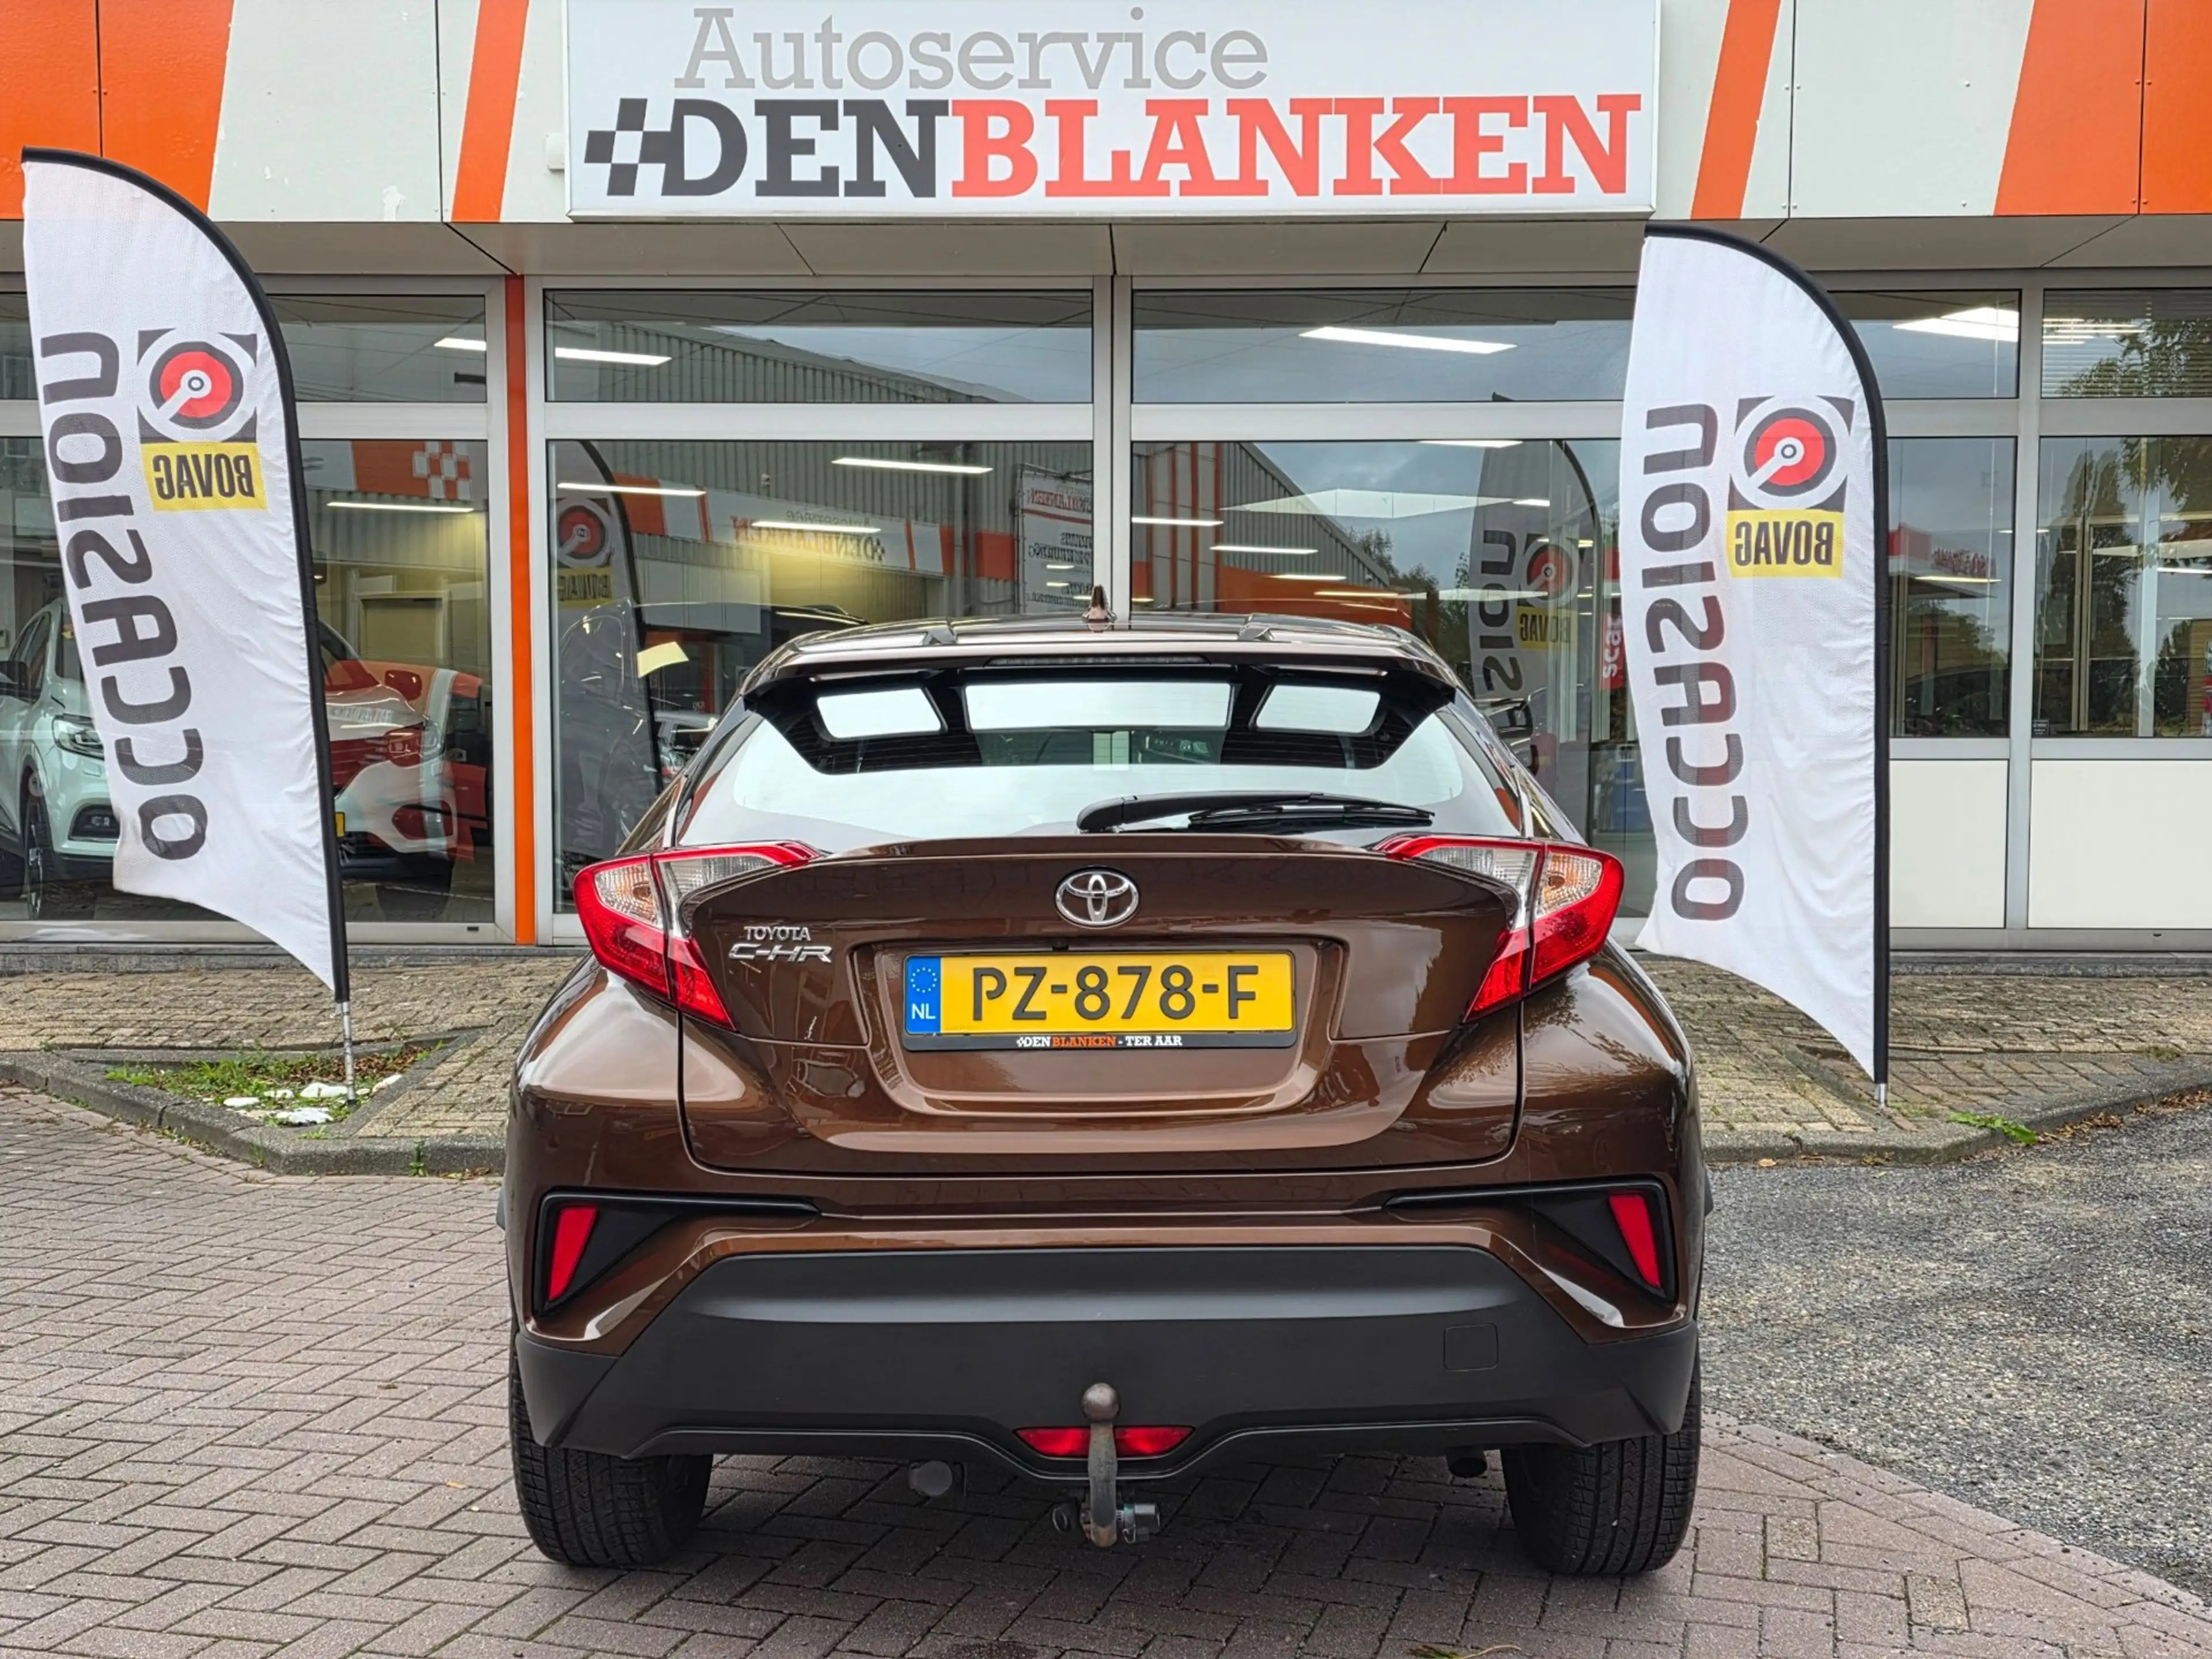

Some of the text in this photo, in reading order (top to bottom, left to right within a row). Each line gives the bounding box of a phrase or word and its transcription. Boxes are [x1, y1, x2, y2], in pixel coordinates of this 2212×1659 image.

[673, 7, 1268, 91] Autoservice
[744, 926, 811, 941] TOYOTA
[729, 944, 832, 964] C-HR
[973, 965, 1259, 1021] PZ-878-F
[911, 1003, 936, 1020] NL
[1125, 1035, 1152, 1046] TER
[1154, 1035, 1183, 1046] AAR
